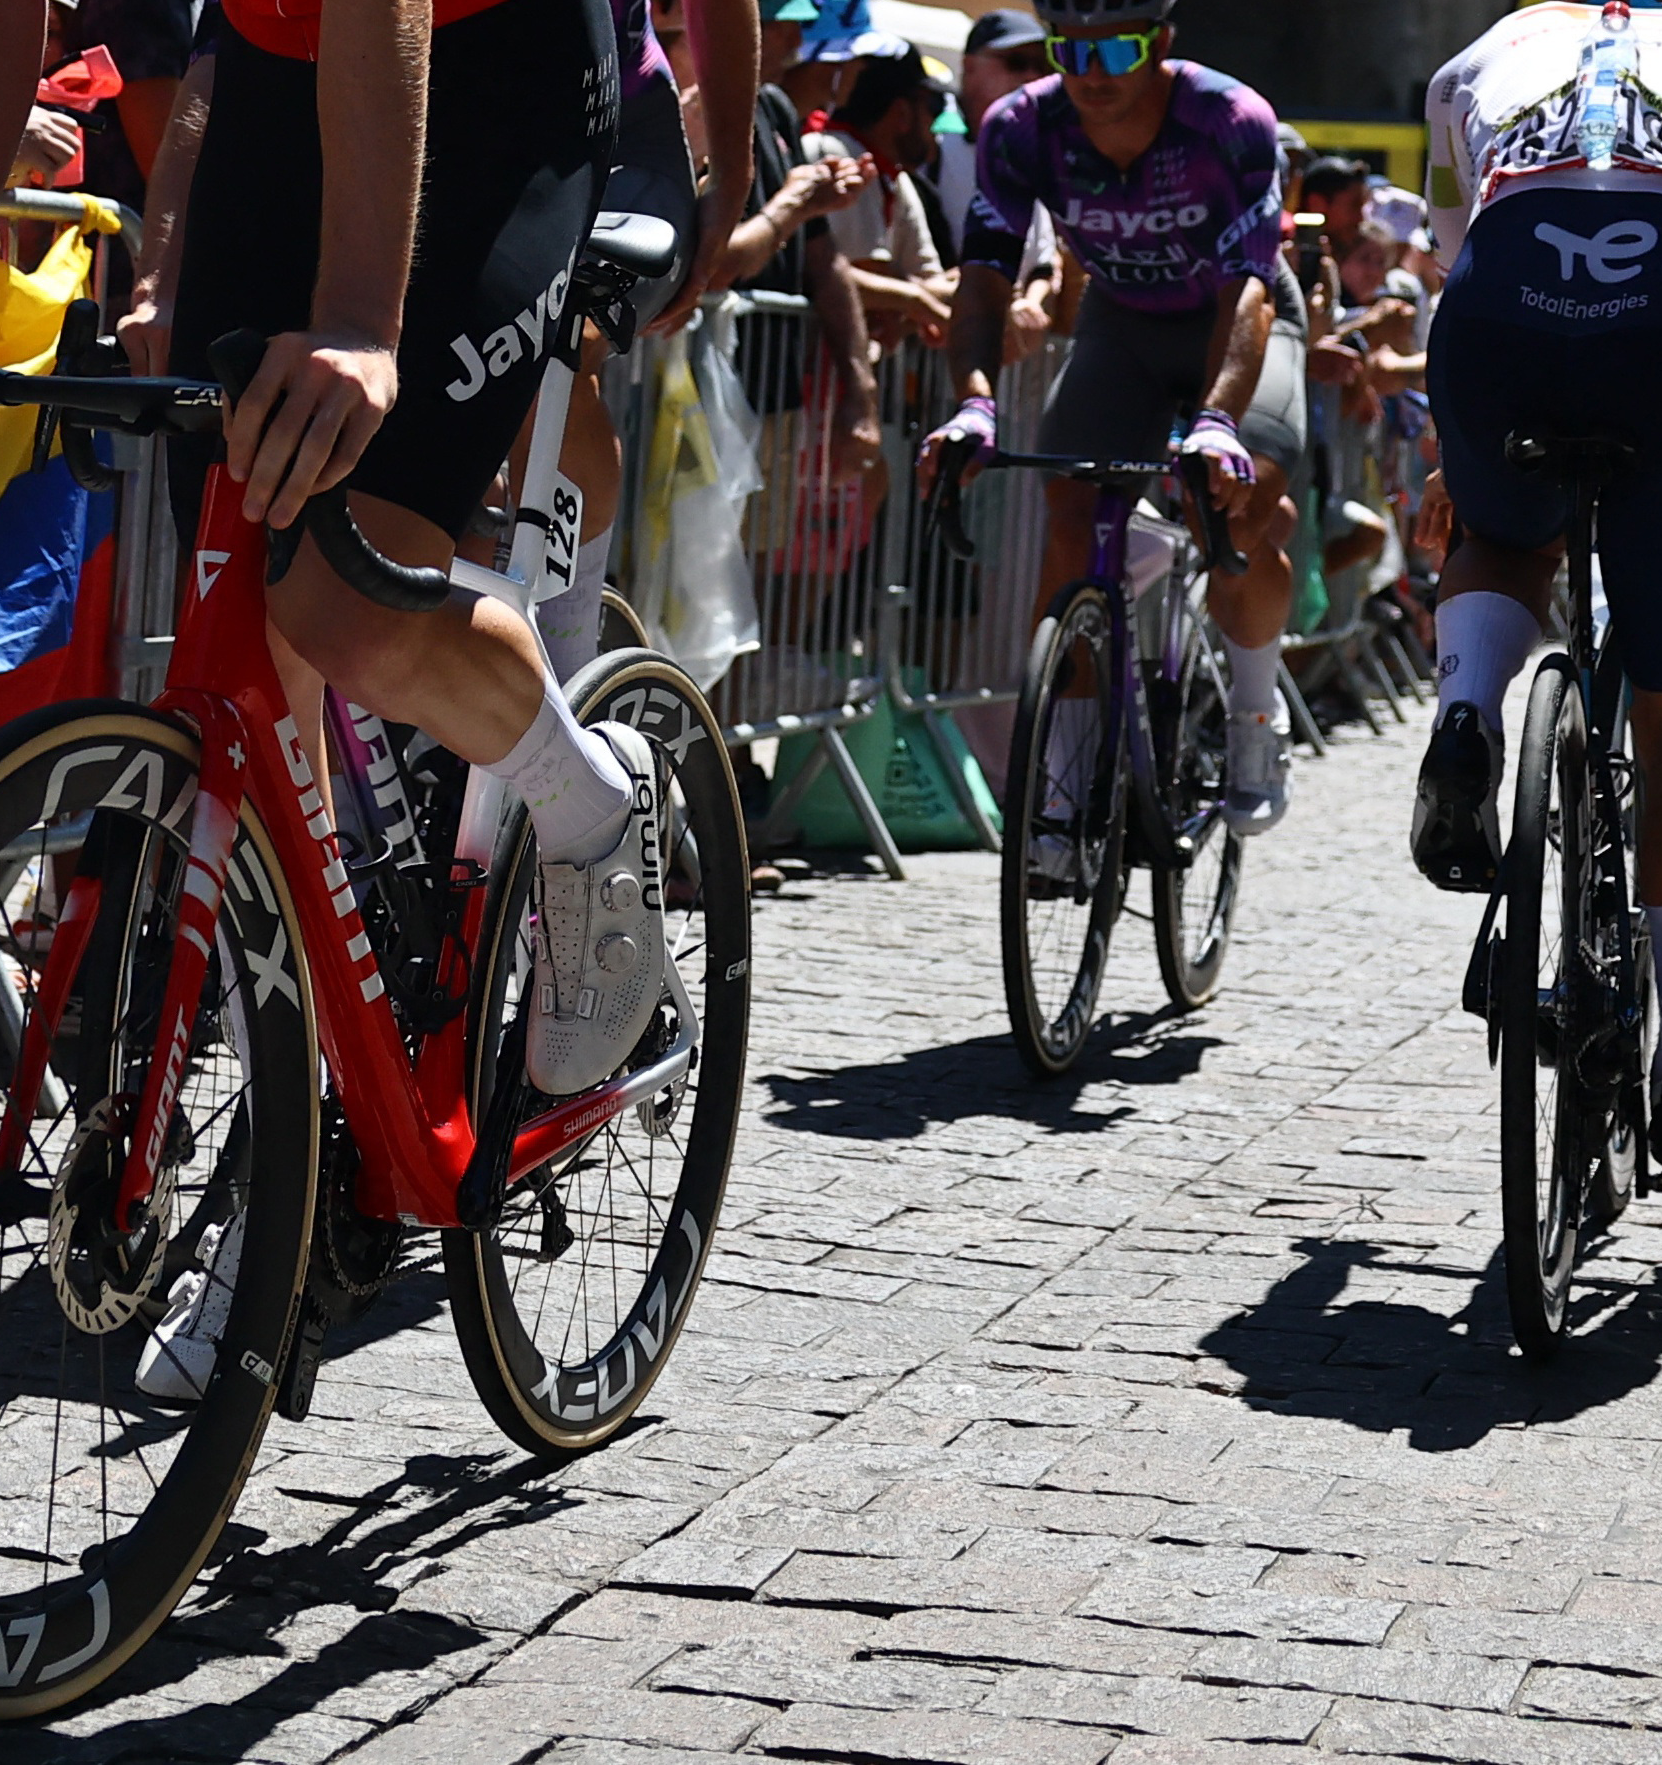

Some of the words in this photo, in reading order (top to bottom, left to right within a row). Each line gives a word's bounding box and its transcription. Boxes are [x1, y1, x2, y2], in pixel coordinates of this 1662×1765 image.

[582, 51, 613, 89] MAAP
[585, 79, 616, 113] MAAP
[1051, 198, 1210, 238] Jayco
[1520, 285, 1650, 320] TotalEnergies
[545, 487, 578, 587] 128
[144, 1002, 190, 1177] GIANT
[562, 1096, 620, 1137] SHIMANO
[530, 1208, 702, 1402] CADEX
